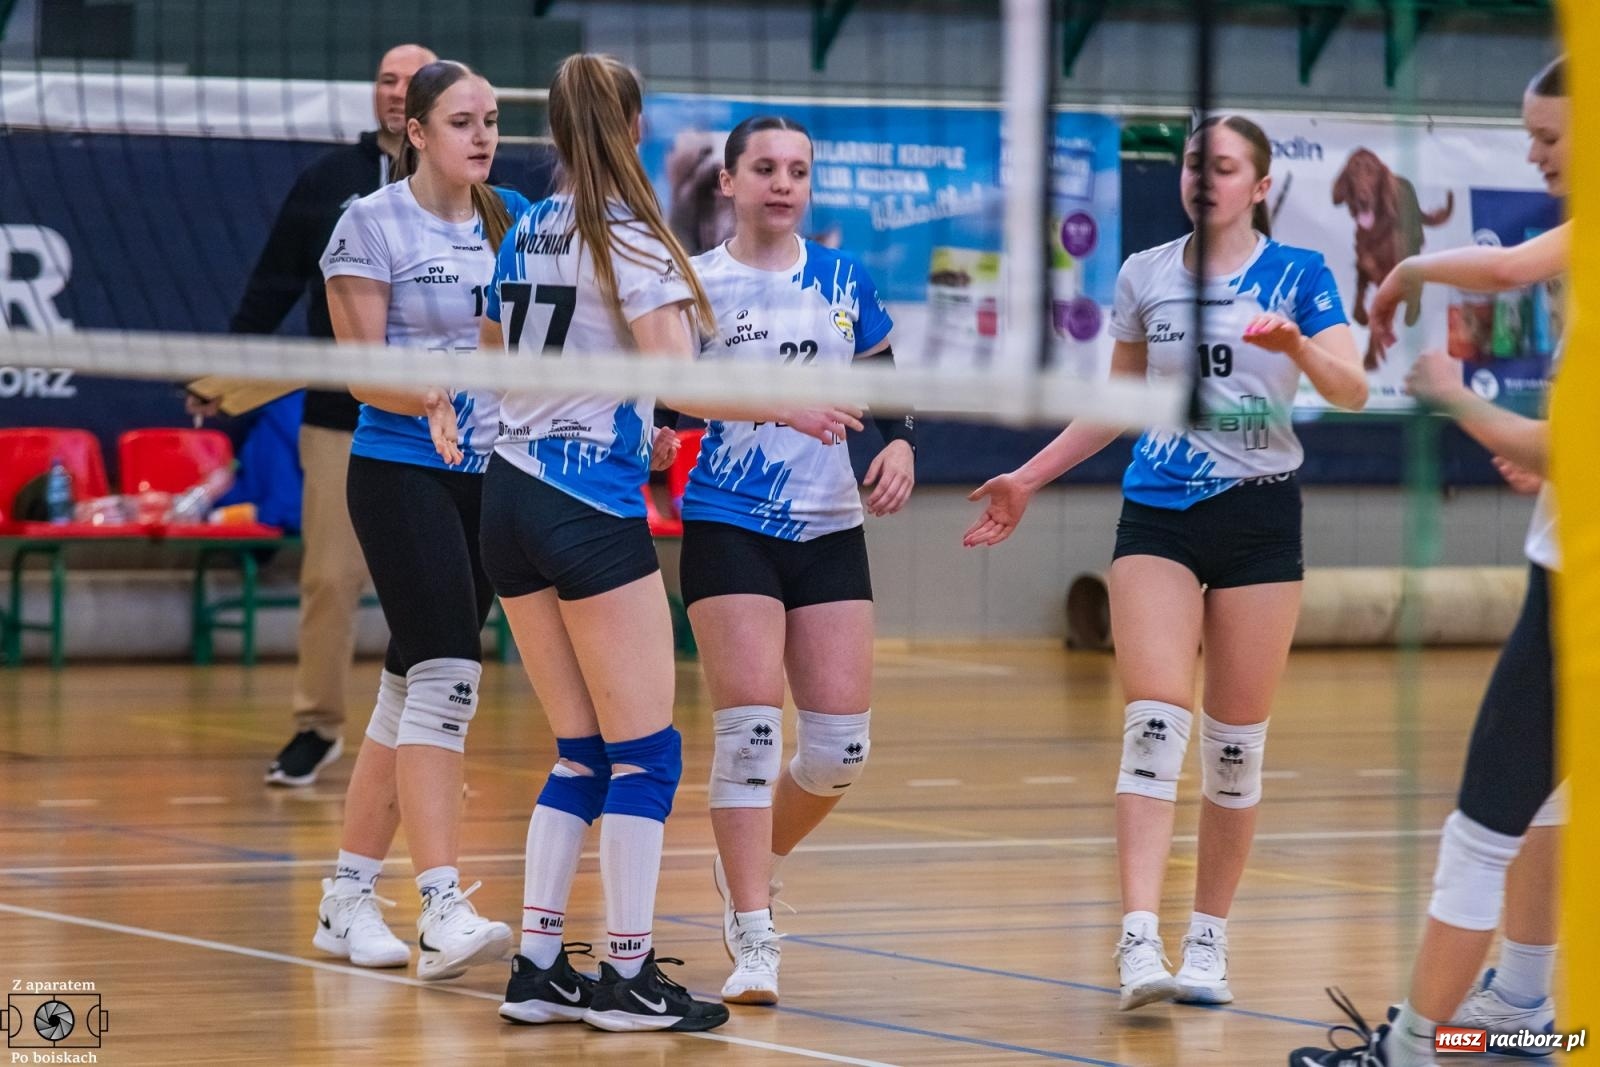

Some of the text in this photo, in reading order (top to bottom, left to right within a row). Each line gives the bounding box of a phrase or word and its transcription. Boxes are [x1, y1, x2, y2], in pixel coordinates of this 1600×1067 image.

[515, 230, 574, 255] WOŹNIAK
[414, 275, 459, 284] VOLLEY
[501, 282, 576, 355] 77
[737, 324, 752, 333] PV
[725, 330, 769, 347] VOLLEY
[780, 340, 818, 366] 22
[1197, 344, 1233, 378] 19
[750, 738, 773, 746] errea
[610, 939, 641, 953] gala
